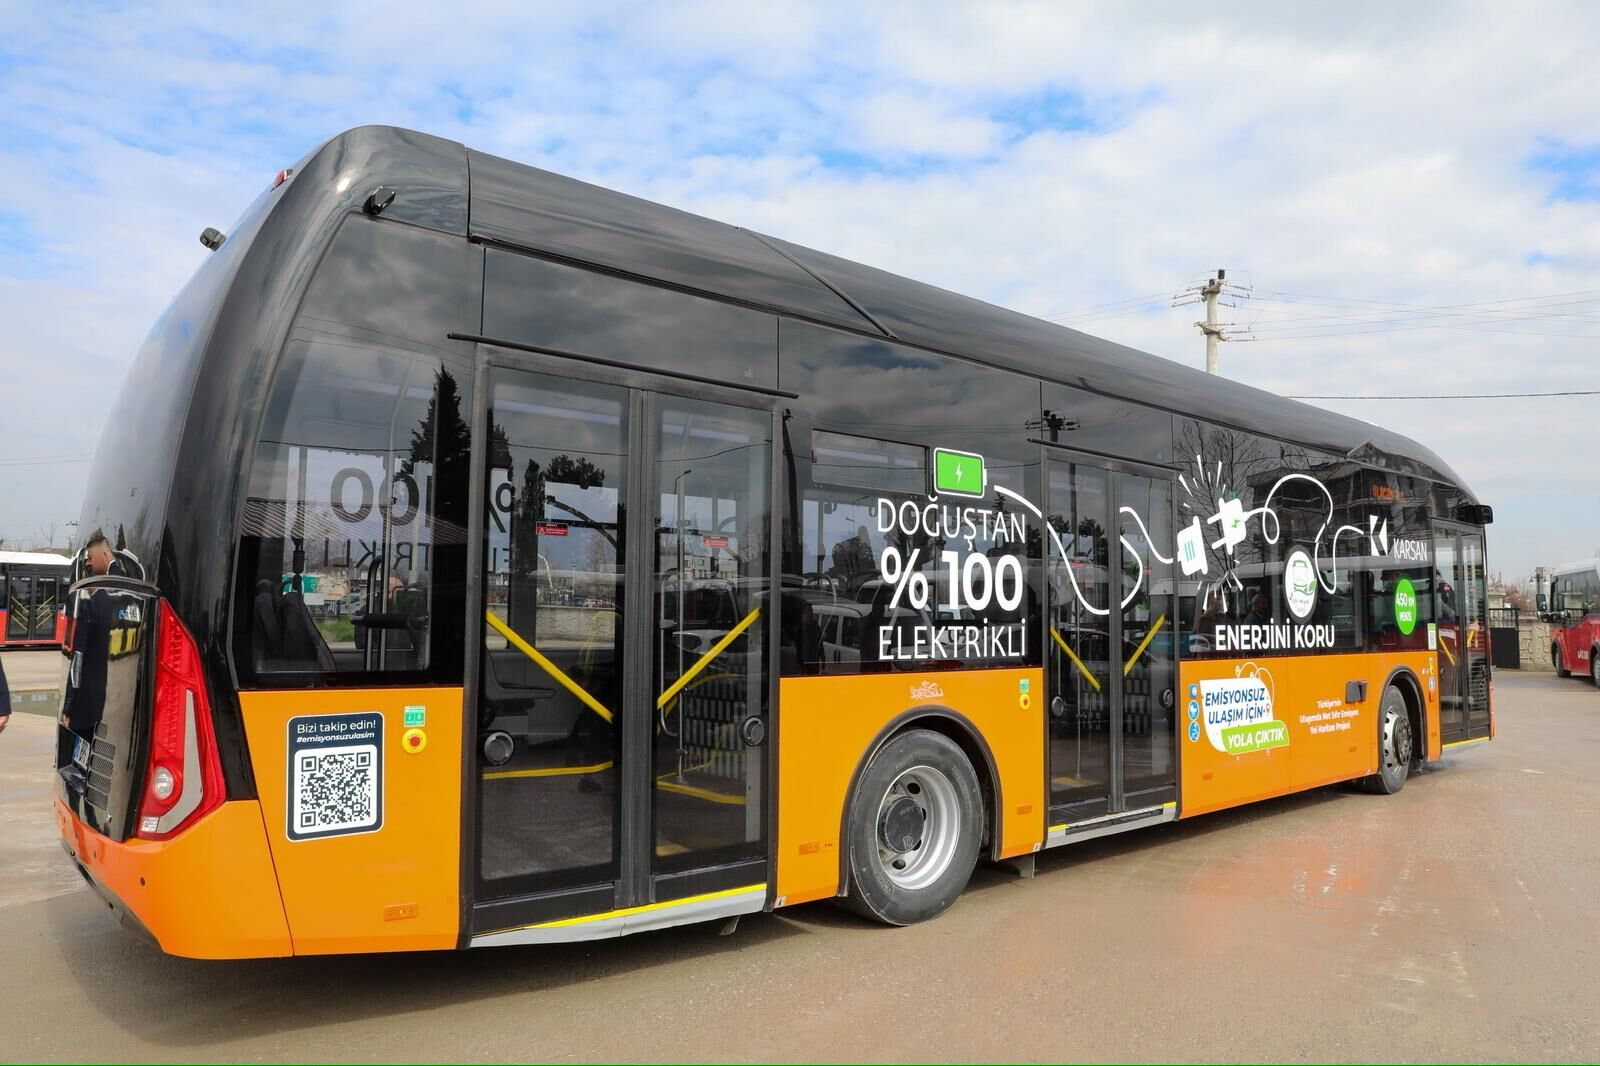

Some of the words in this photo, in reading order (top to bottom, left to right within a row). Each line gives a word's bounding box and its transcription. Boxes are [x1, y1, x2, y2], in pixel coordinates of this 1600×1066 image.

[877, 495, 1026, 551] DOĞUŞTAN
[1393, 537, 1428, 562] KARSAN
[942, 550, 1023, 611] 100
[1396, 592, 1408, 607] 450
[879, 618, 1026, 660] ELEKTRİKLİ
[1215, 618, 1291, 651] ENERJİNİ
[1294, 624, 1335, 649] KORU
[1205, 687, 1265, 706] EMİSYONSUZ
[297, 722, 317, 734] Bizi
[319, 721, 347, 733] takip
[349, 719, 376, 730] edin!
[1208, 708, 1243, 727] ULAŞIM
[1245, 703, 1263, 722] İÇİN
[296, 731, 375, 744] #emisyonsuzulasim
[1227, 733, 1253, 749] YOLA
[1255, 727, 1285, 748] ÇIKTIK
[1309, 726, 1318, 734] Yol
